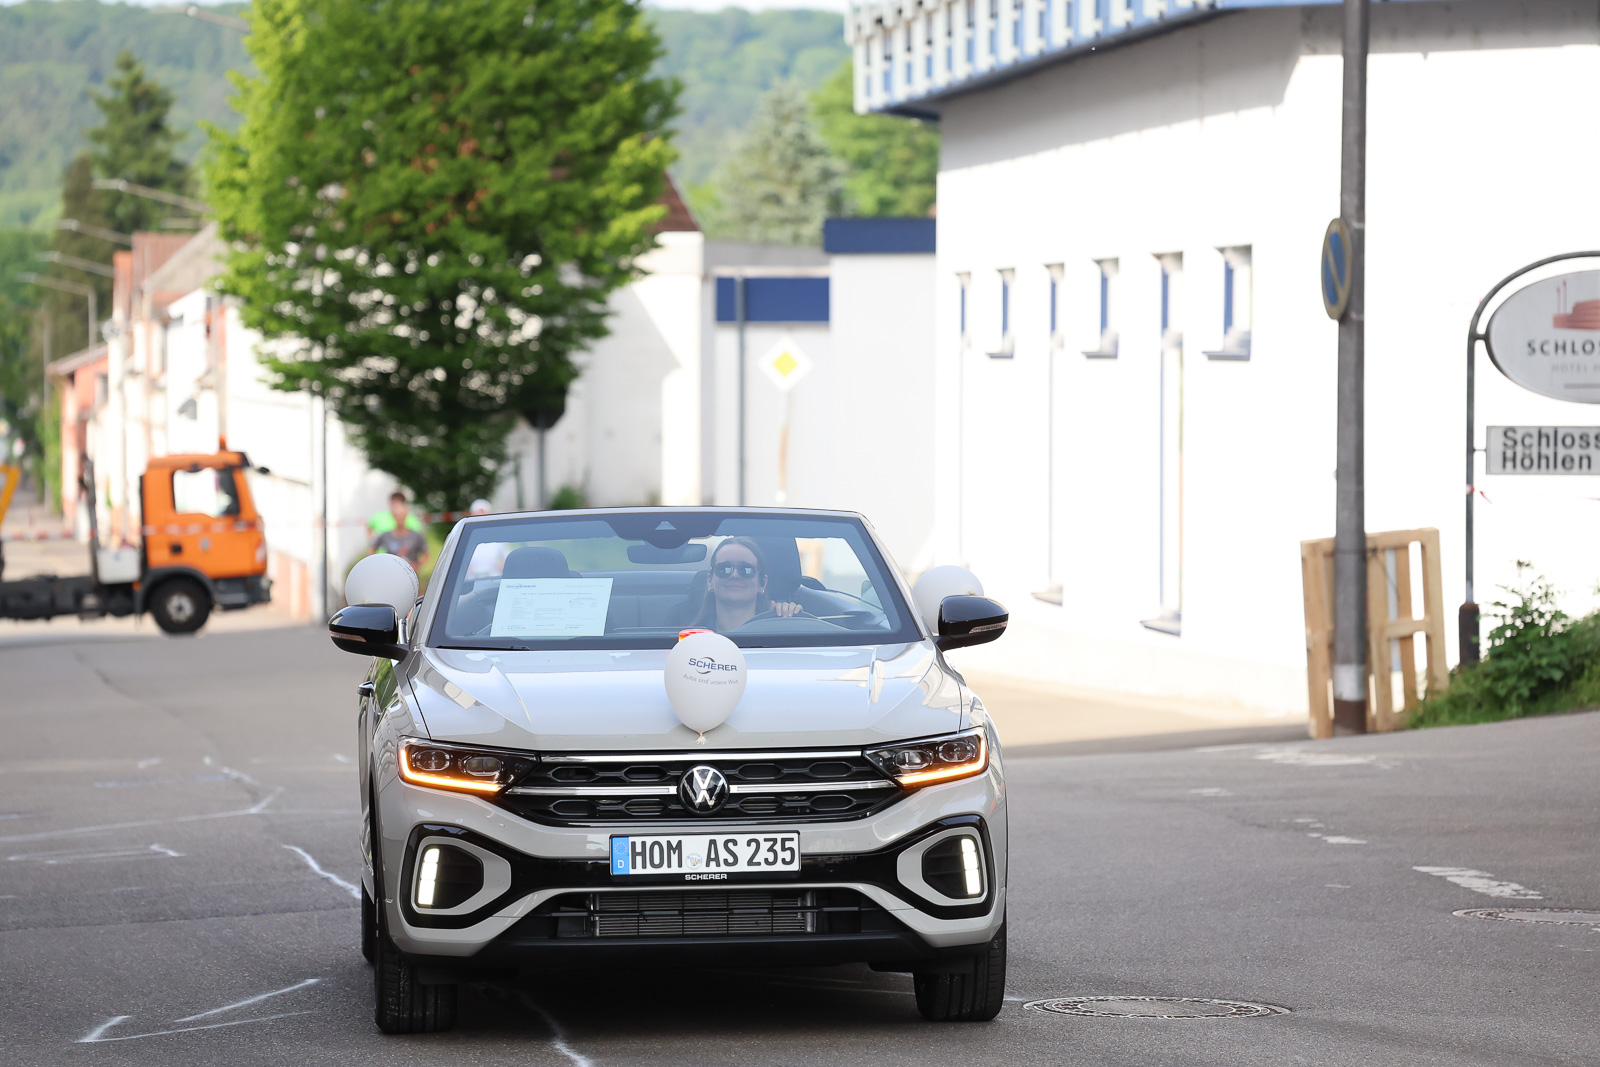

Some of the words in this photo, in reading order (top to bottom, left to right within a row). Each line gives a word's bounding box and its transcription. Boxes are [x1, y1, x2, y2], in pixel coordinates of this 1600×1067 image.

[1527, 339, 1600, 356] SCHLO
[1502, 449, 1591, 470] Höhlen
[688, 657, 738, 671] SCHERER
[682, 673, 697, 682] Autos
[698, 677, 709, 685] sind
[630, 839, 683, 870] HOM
[705, 838, 739, 868] AS
[746, 837, 796, 867] 235
[617, 859, 625, 869] D
[684, 873, 728, 881] SCHERER
